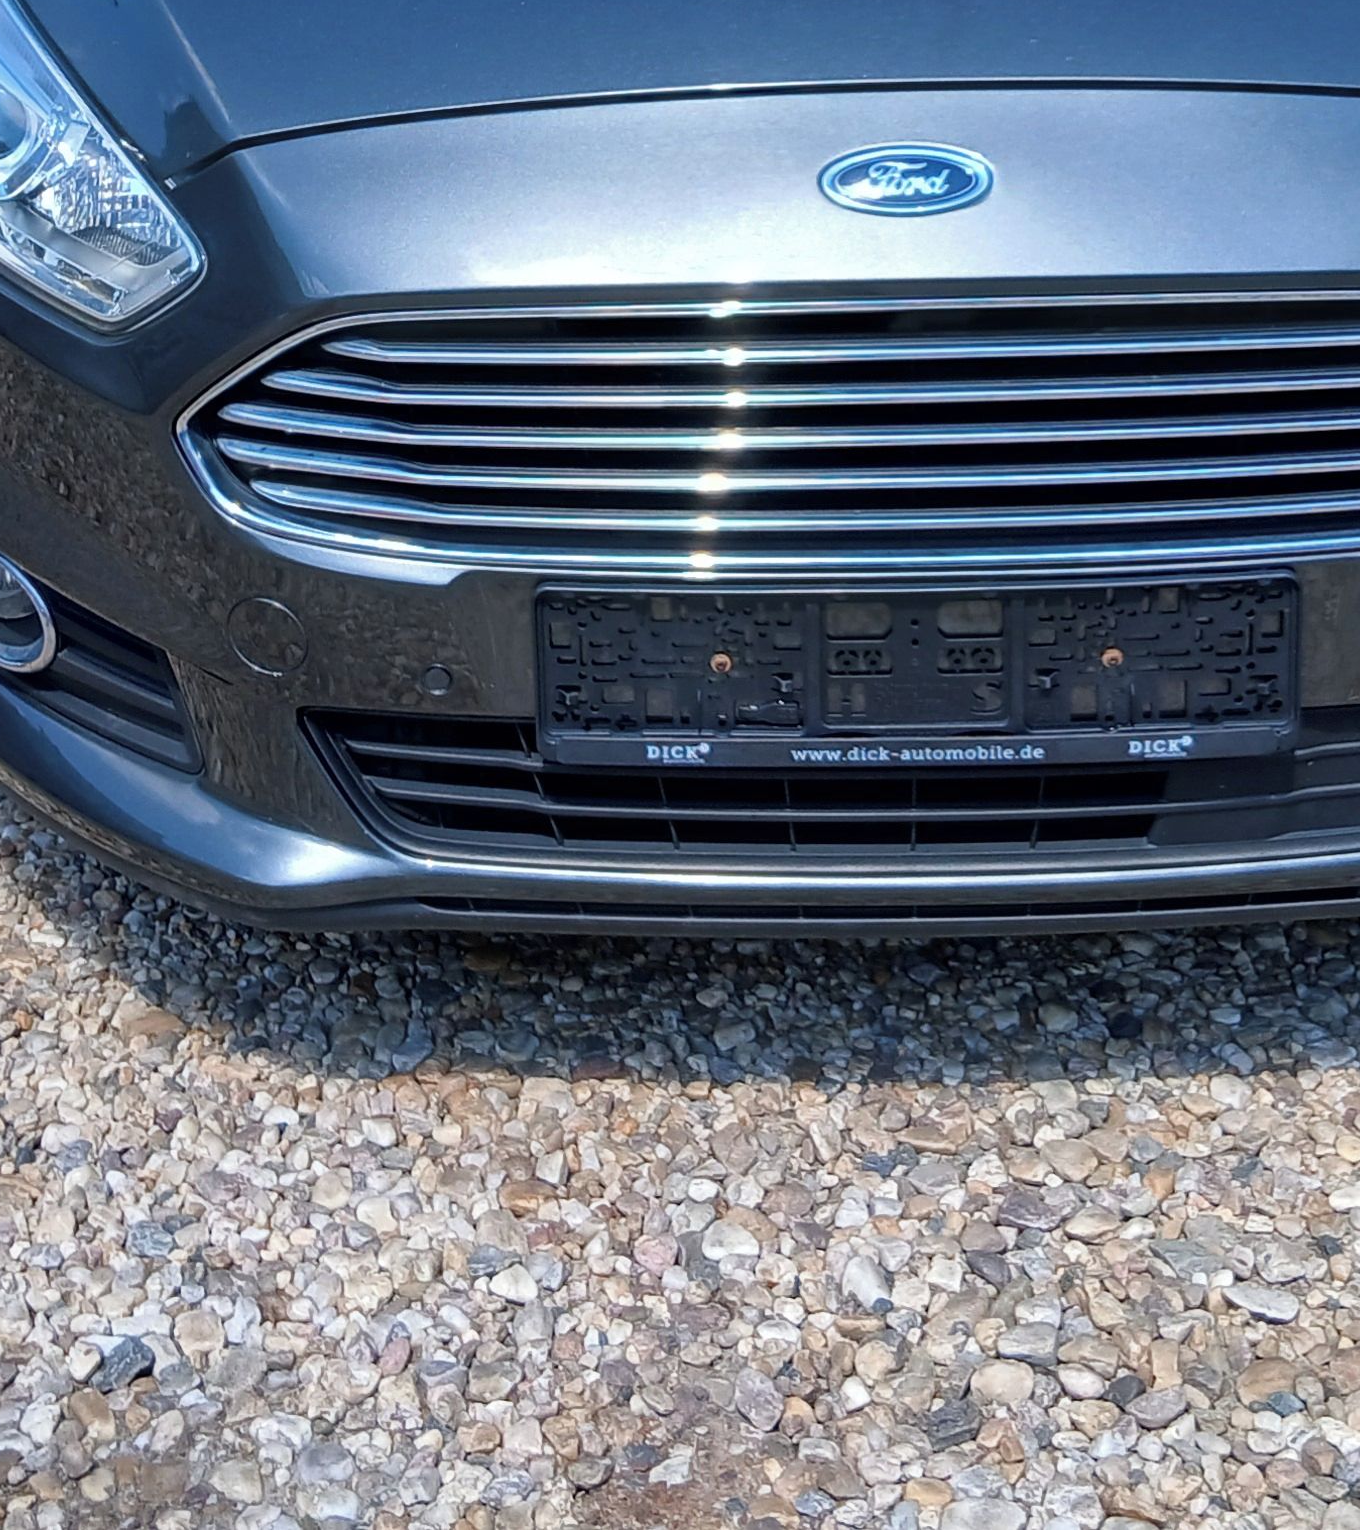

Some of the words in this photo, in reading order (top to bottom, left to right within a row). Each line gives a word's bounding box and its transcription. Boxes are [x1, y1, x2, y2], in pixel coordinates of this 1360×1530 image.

[861, 160, 951, 197] Ford
[647, 744, 700, 759] DICK
[791, 743, 1045, 762] www.dick-automobile.de
[1129, 738, 1183, 754] DICK
